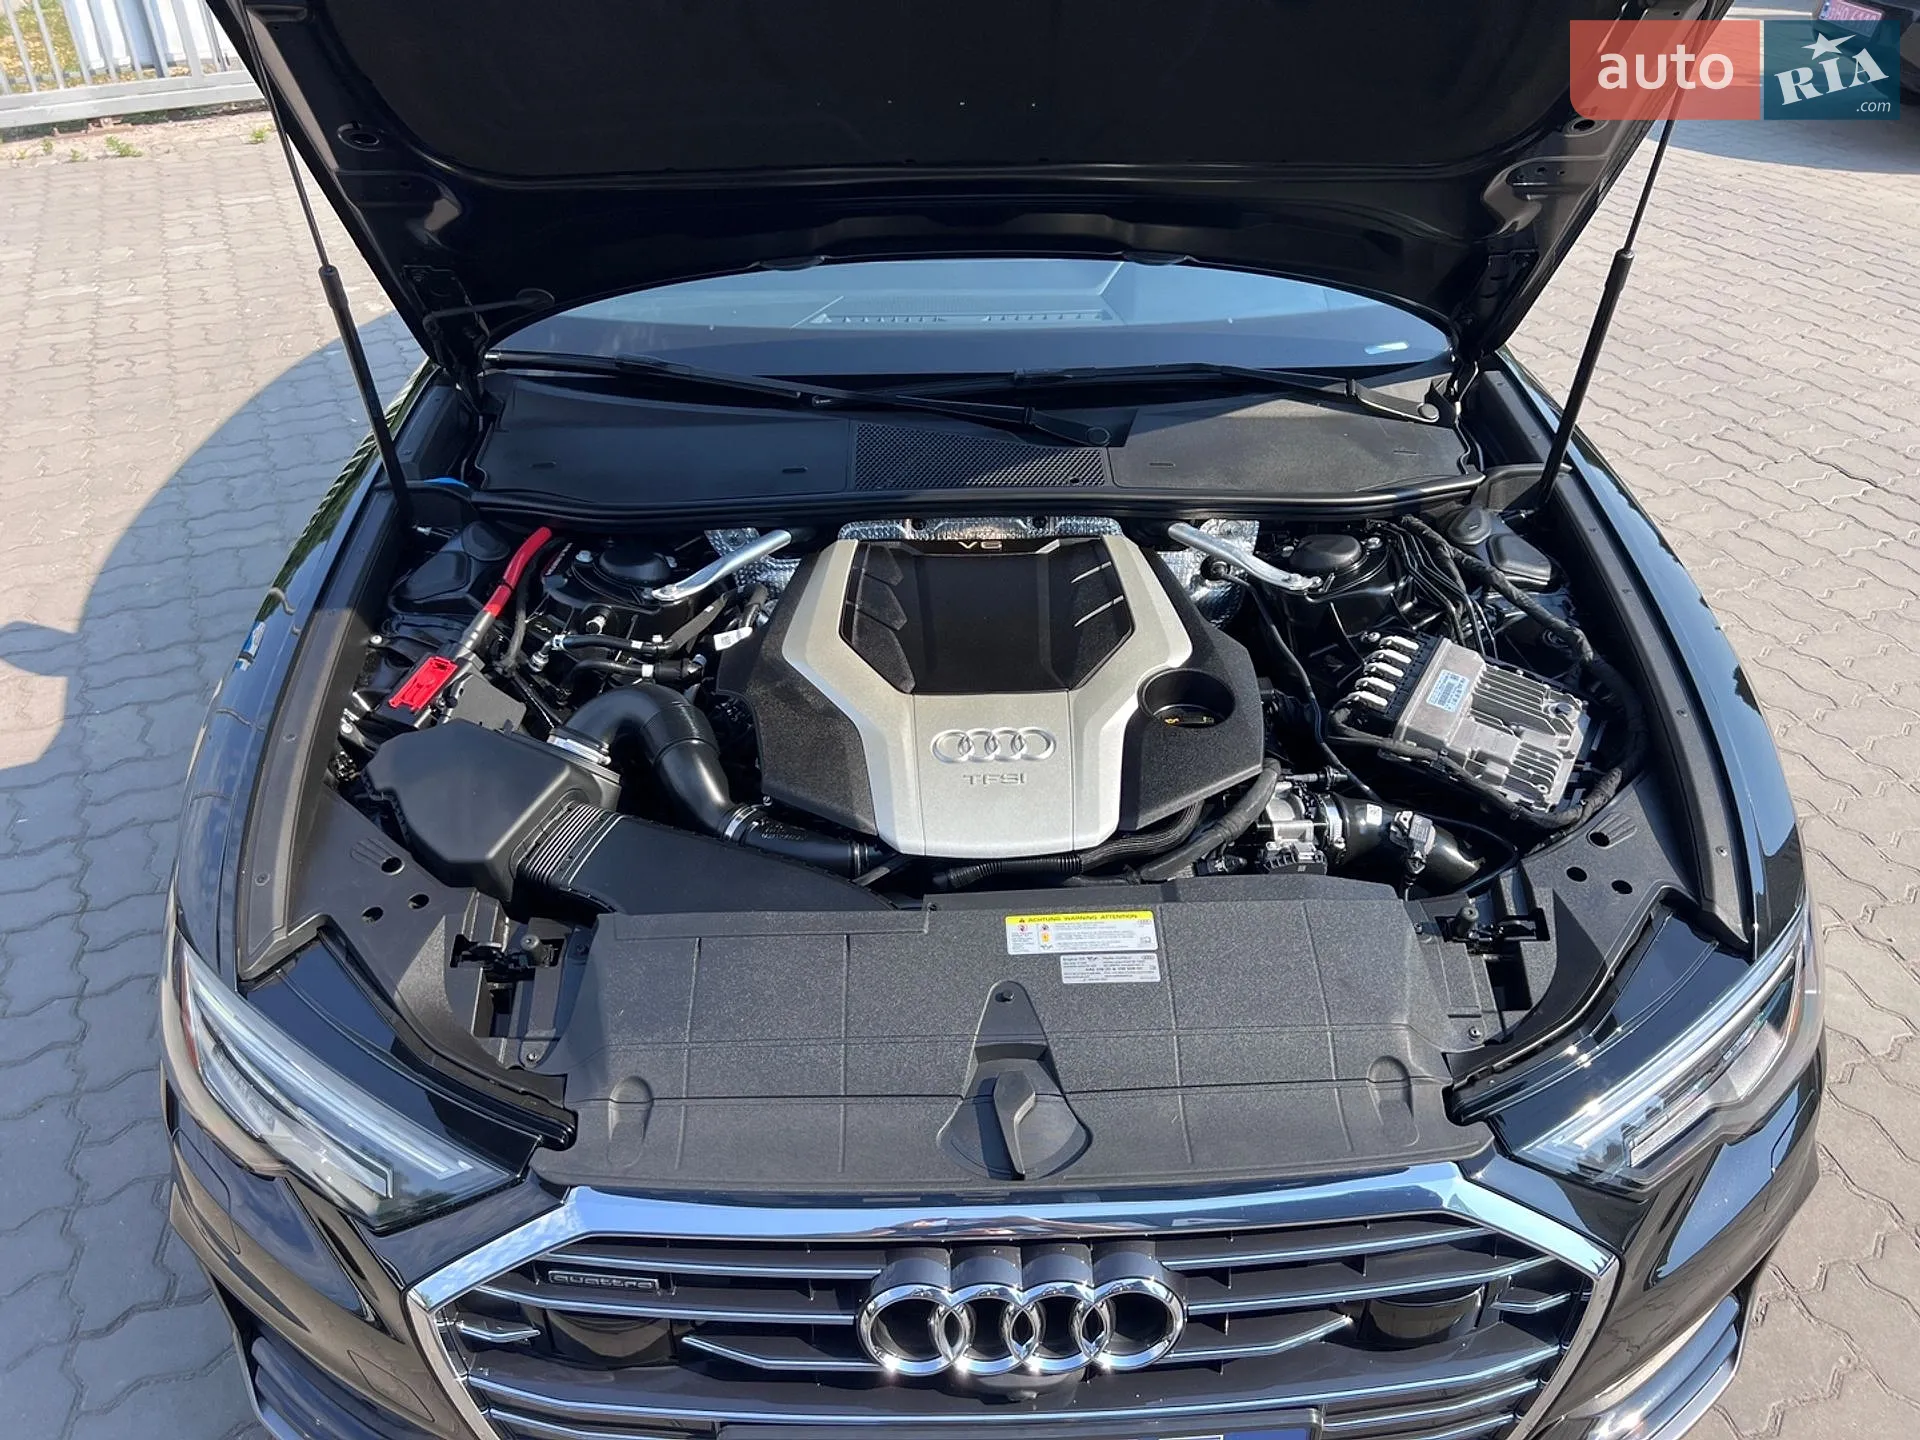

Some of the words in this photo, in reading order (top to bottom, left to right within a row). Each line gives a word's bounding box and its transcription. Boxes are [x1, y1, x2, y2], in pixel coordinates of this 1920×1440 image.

[957, 541, 1003, 550] V6
[963, 773, 1025, 785] TFSI
[553, 1273, 652, 1289] quattro
